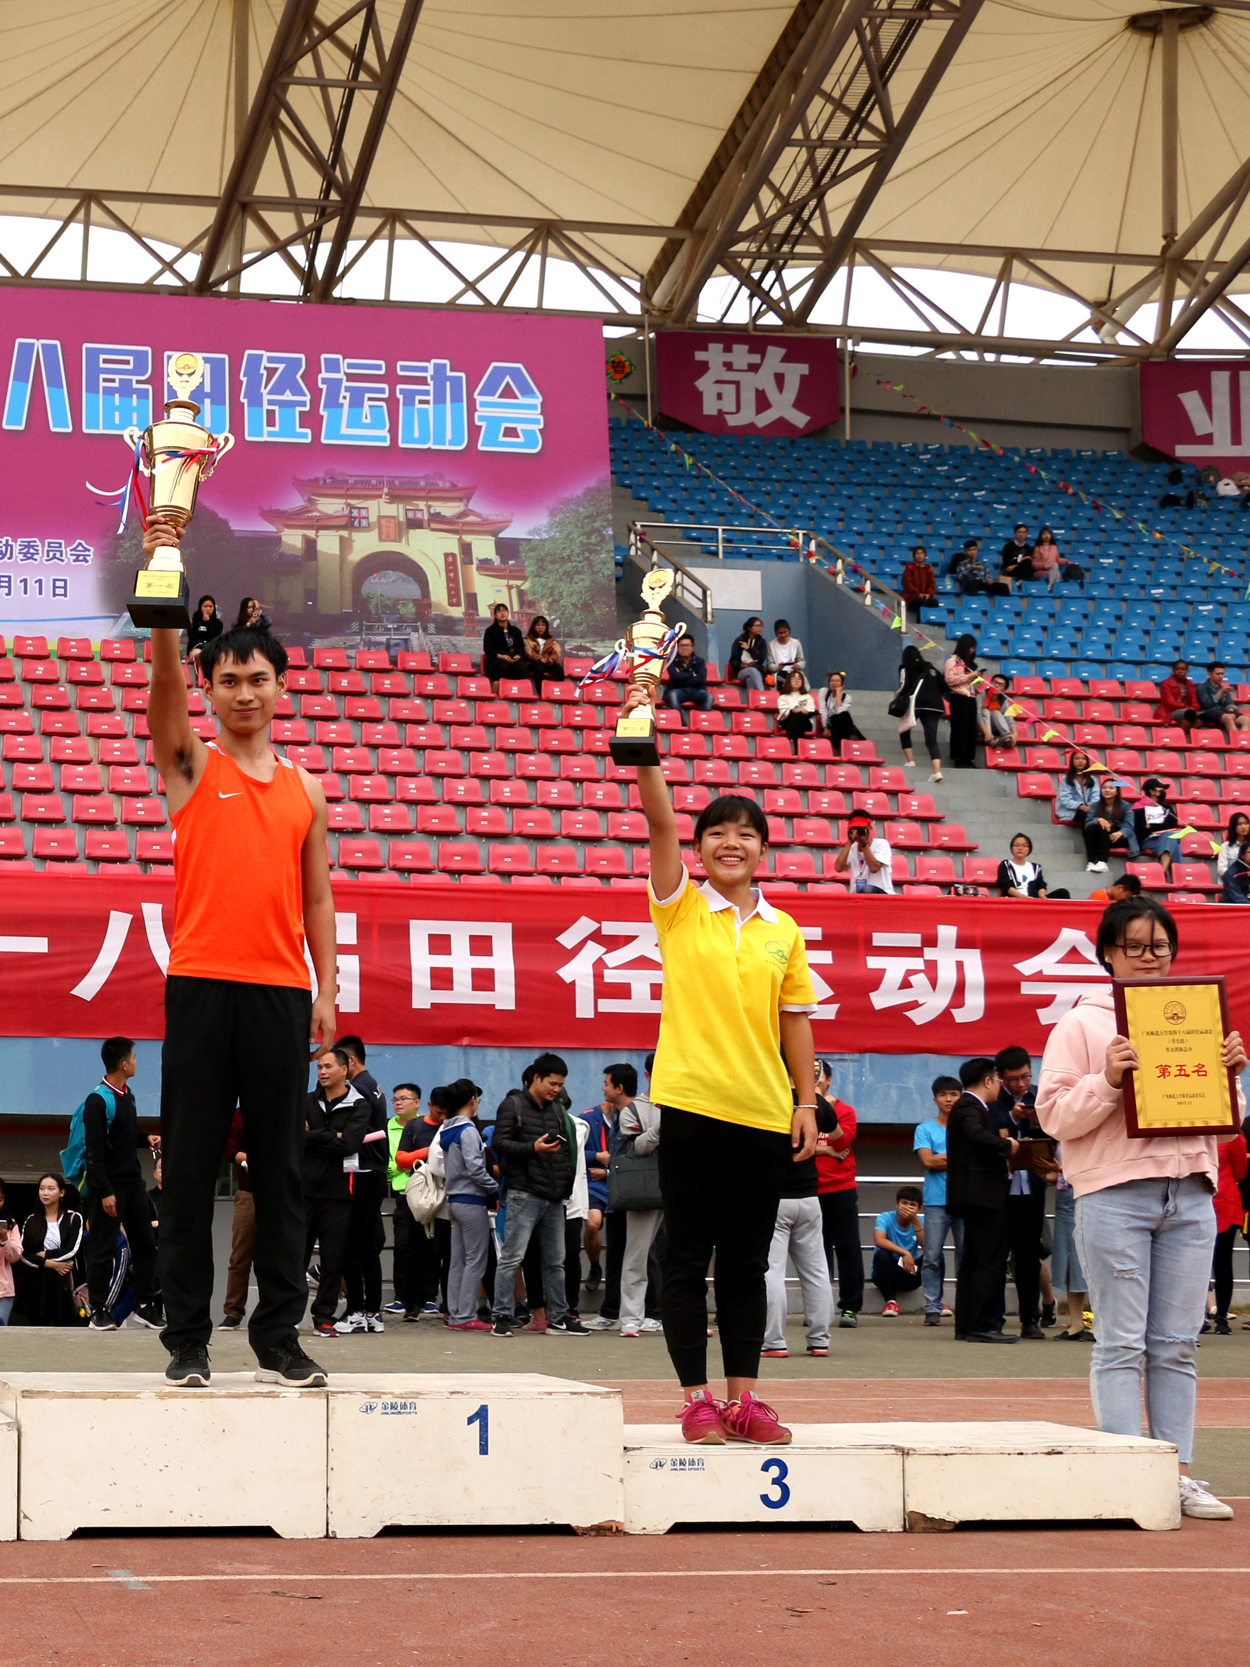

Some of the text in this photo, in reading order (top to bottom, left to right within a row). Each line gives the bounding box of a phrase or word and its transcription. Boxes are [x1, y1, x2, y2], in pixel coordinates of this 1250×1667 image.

[693, 343, 811, 429] 敬
[1155, 1063, 1208, 1079] 第五名
[381, 1401, 417, 1410] 金陵体育
[467, 1405, 488, 1455] 1
[670, 1458, 704, 1466] 金陵体育
[759, 1458, 790, 1509] 3
